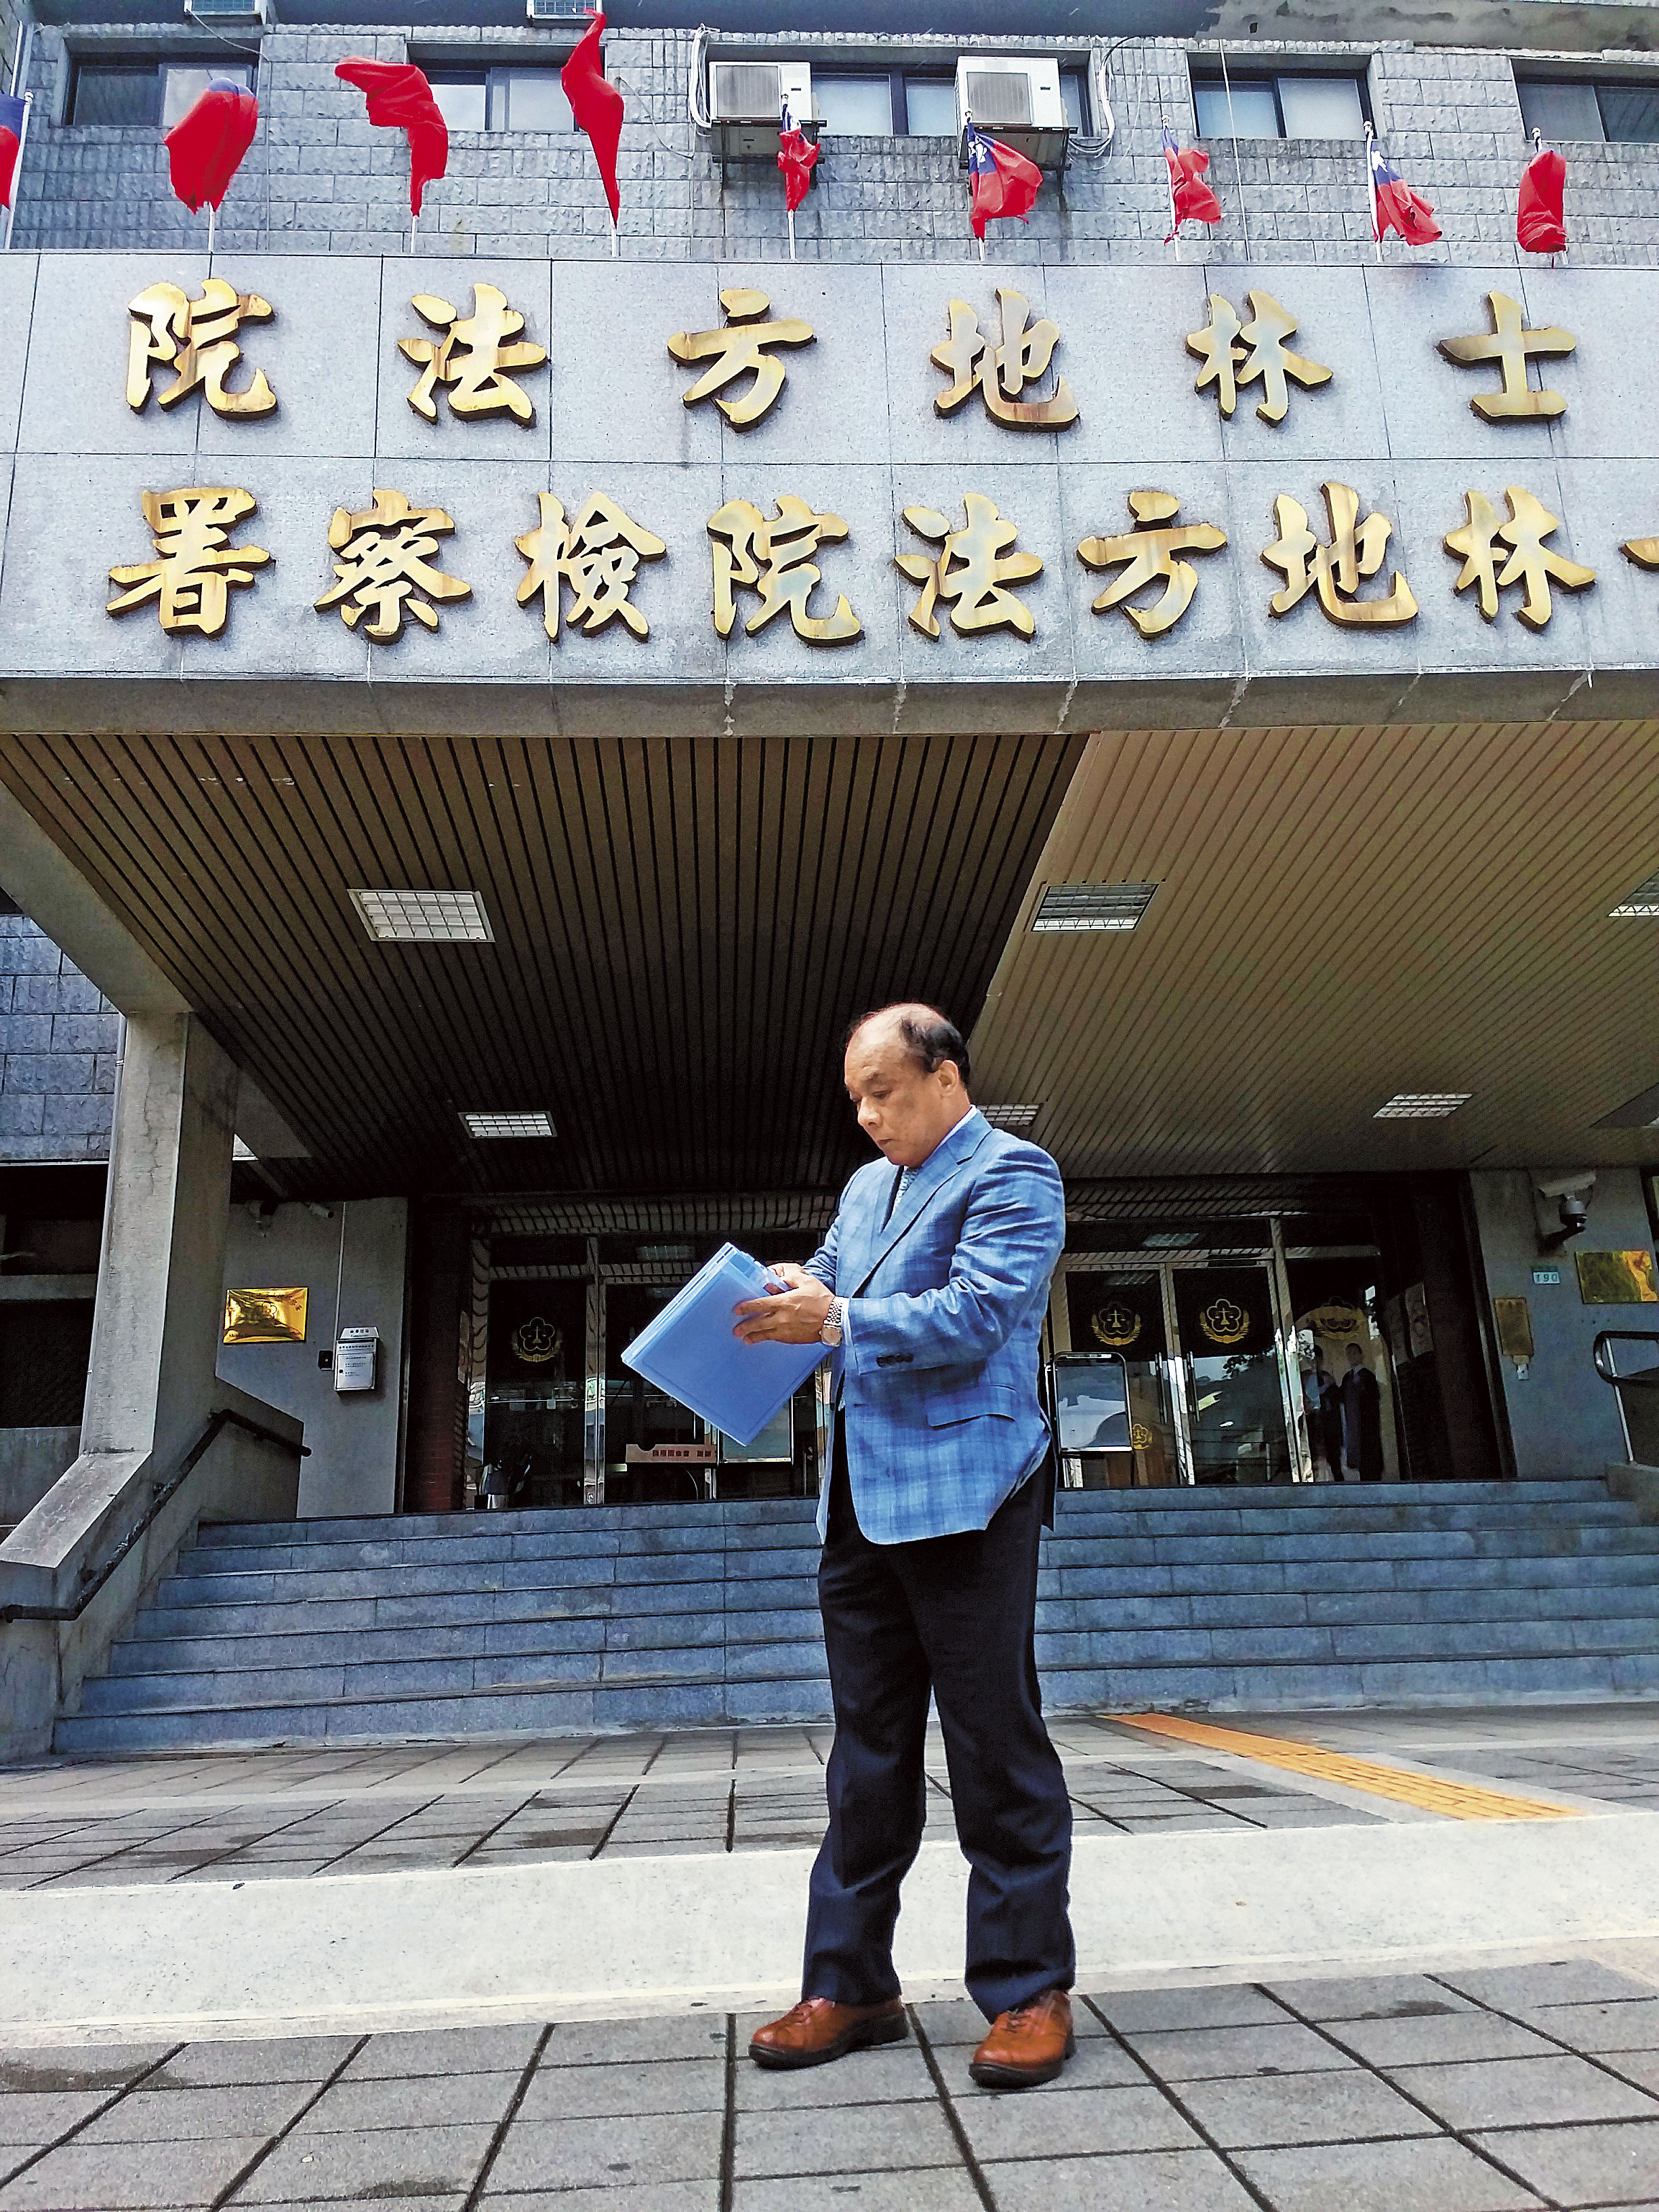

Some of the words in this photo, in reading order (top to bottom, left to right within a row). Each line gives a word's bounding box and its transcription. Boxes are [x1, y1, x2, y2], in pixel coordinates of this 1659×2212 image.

[106, 483, 1659, 644] 林地方法院檢察署
[1536, 1273, 1557, 1282] 190
